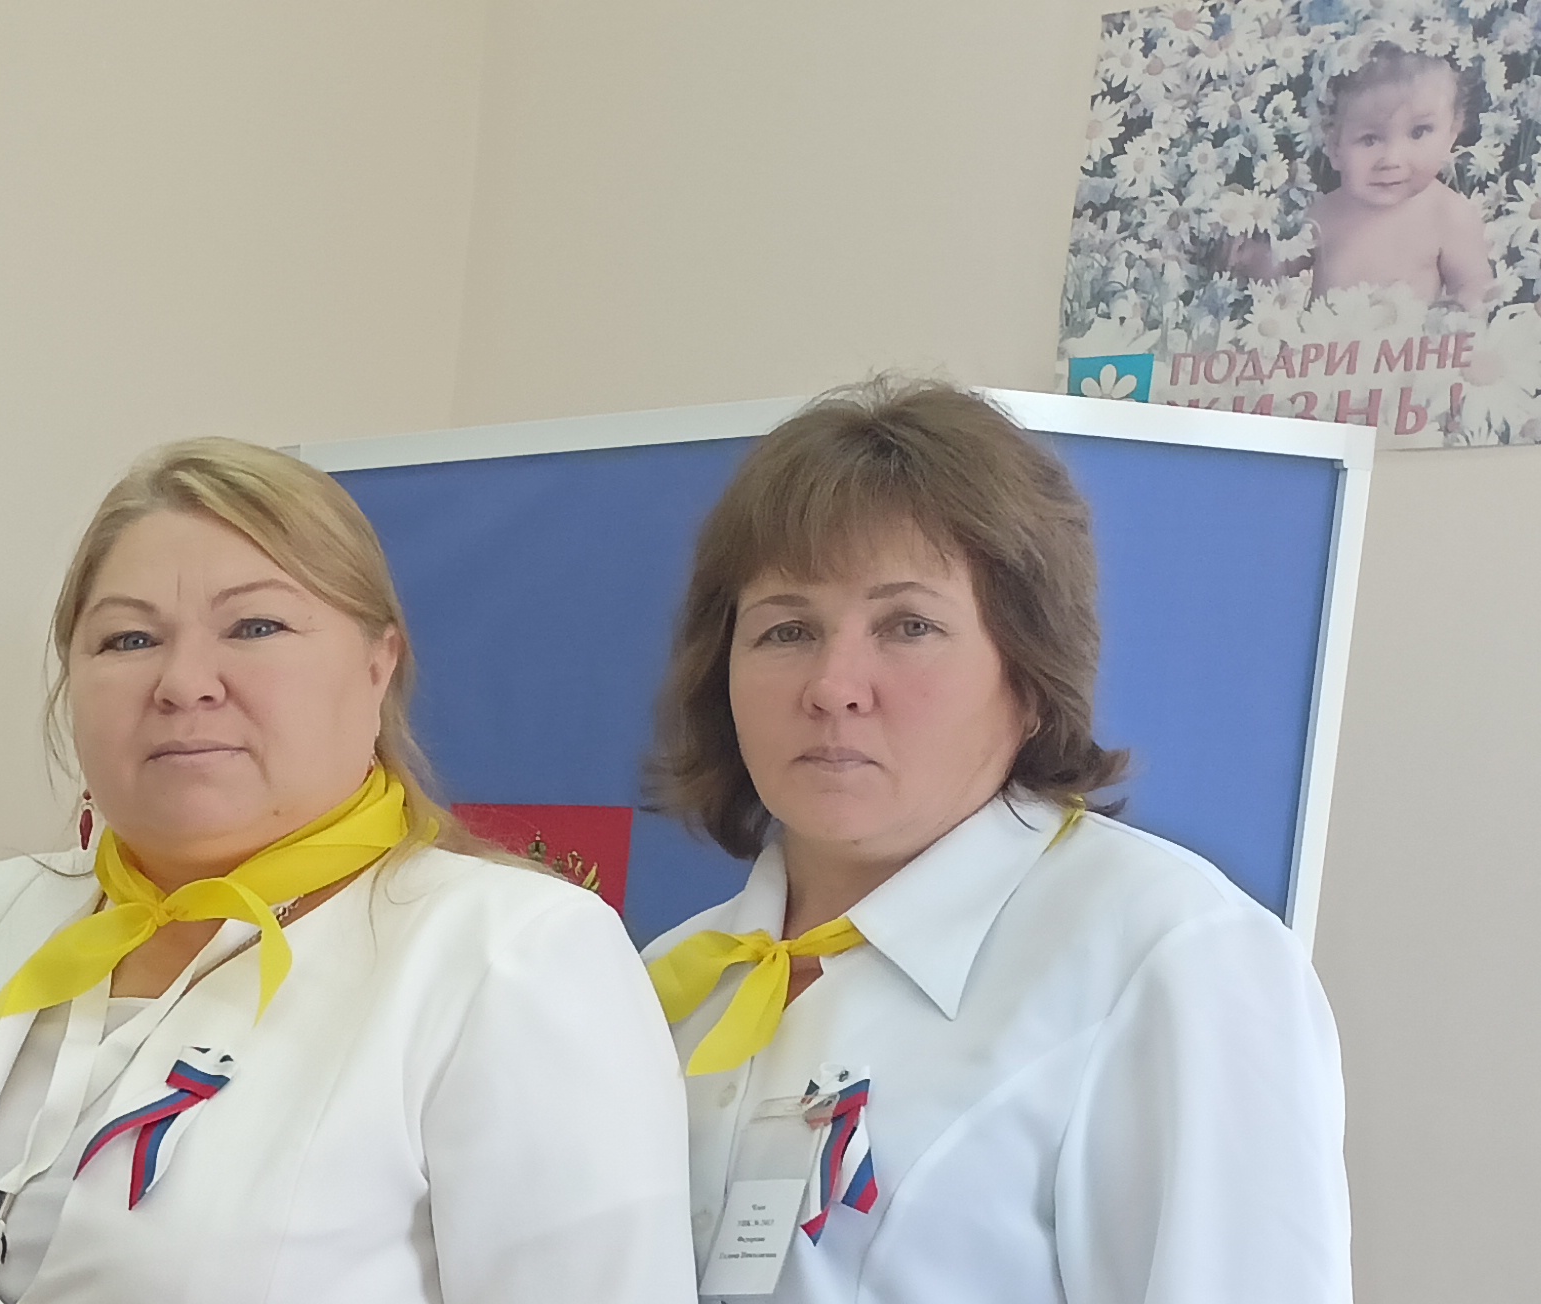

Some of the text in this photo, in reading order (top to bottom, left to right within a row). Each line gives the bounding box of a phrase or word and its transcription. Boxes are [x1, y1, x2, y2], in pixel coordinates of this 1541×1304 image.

[1169, 332, 1475, 386] ПОДАРИ МНЕ
[1167, 382, 1463, 436] ЗНЬ!
